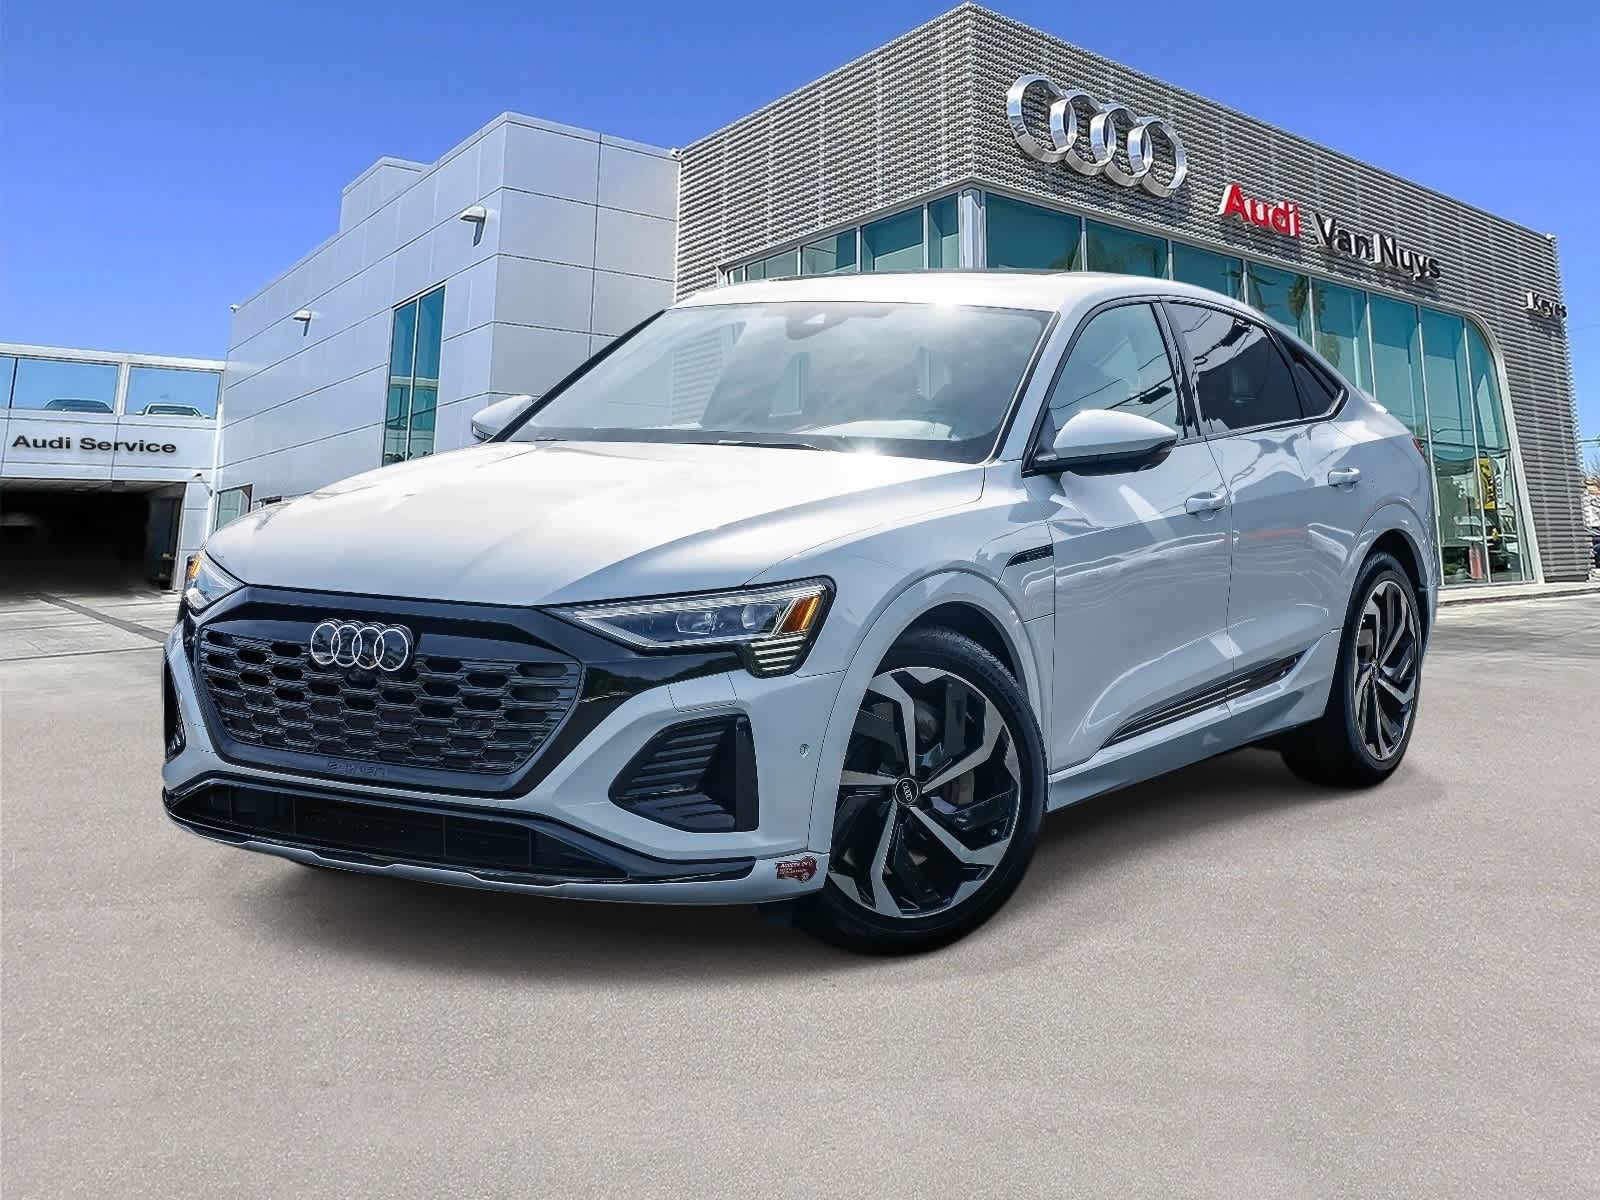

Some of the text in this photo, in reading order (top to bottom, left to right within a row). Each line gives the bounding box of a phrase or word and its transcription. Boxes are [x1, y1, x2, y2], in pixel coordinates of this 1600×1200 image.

[1218, 182, 1440, 281] Audi Van Nuys
[1527, 291, 1567, 319] Keyes
[12, 435, 177, 454] Audi Service
